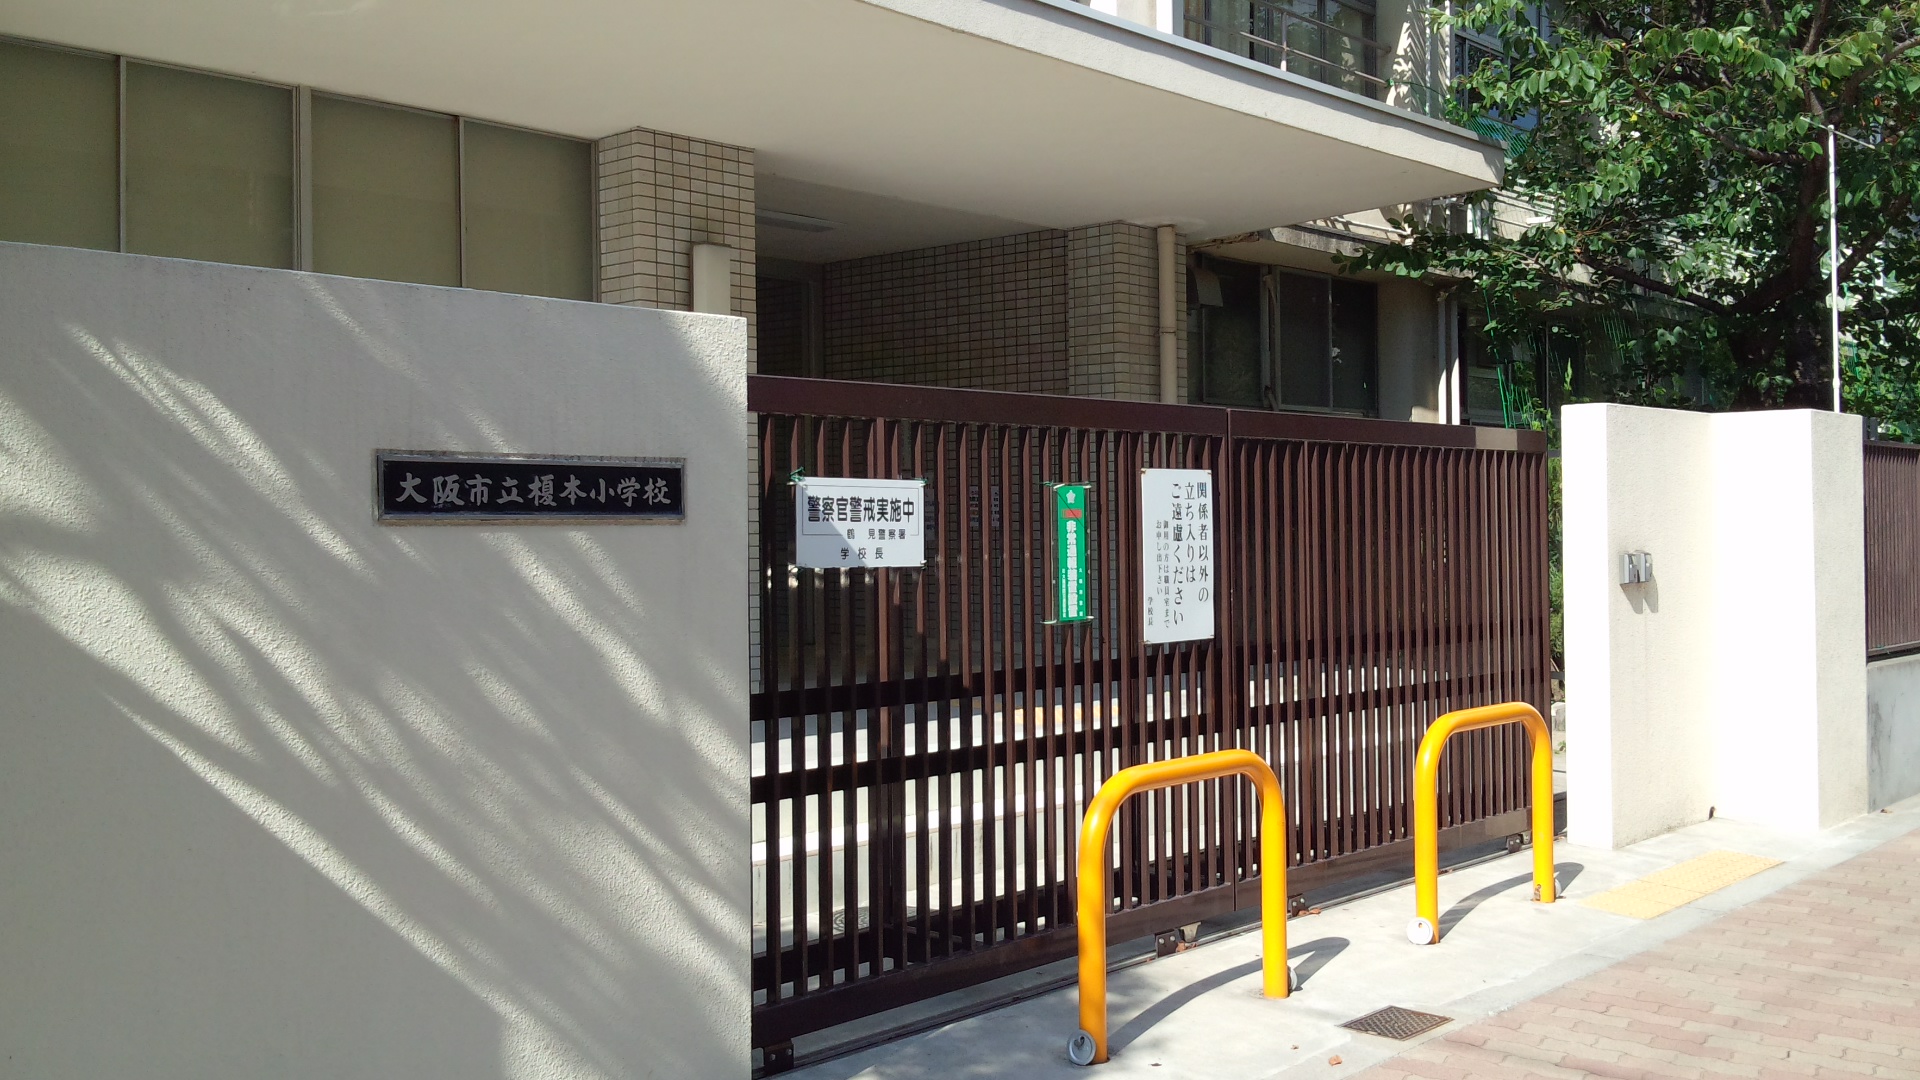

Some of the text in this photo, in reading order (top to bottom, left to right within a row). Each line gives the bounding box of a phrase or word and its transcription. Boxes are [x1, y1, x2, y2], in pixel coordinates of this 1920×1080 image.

[395, 472, 672, 507] 大阪市立榎本小学校
[807, 495, 915, 523] 警察官警戒実施中
[840, 547, 884, 560] 学校長
[1172, 483, 1184, 625] ご遠慮ください
[1184, 481, 1196, 582] 立ち入りは
[1197, 481, 1209, 603] 関係者以外の
